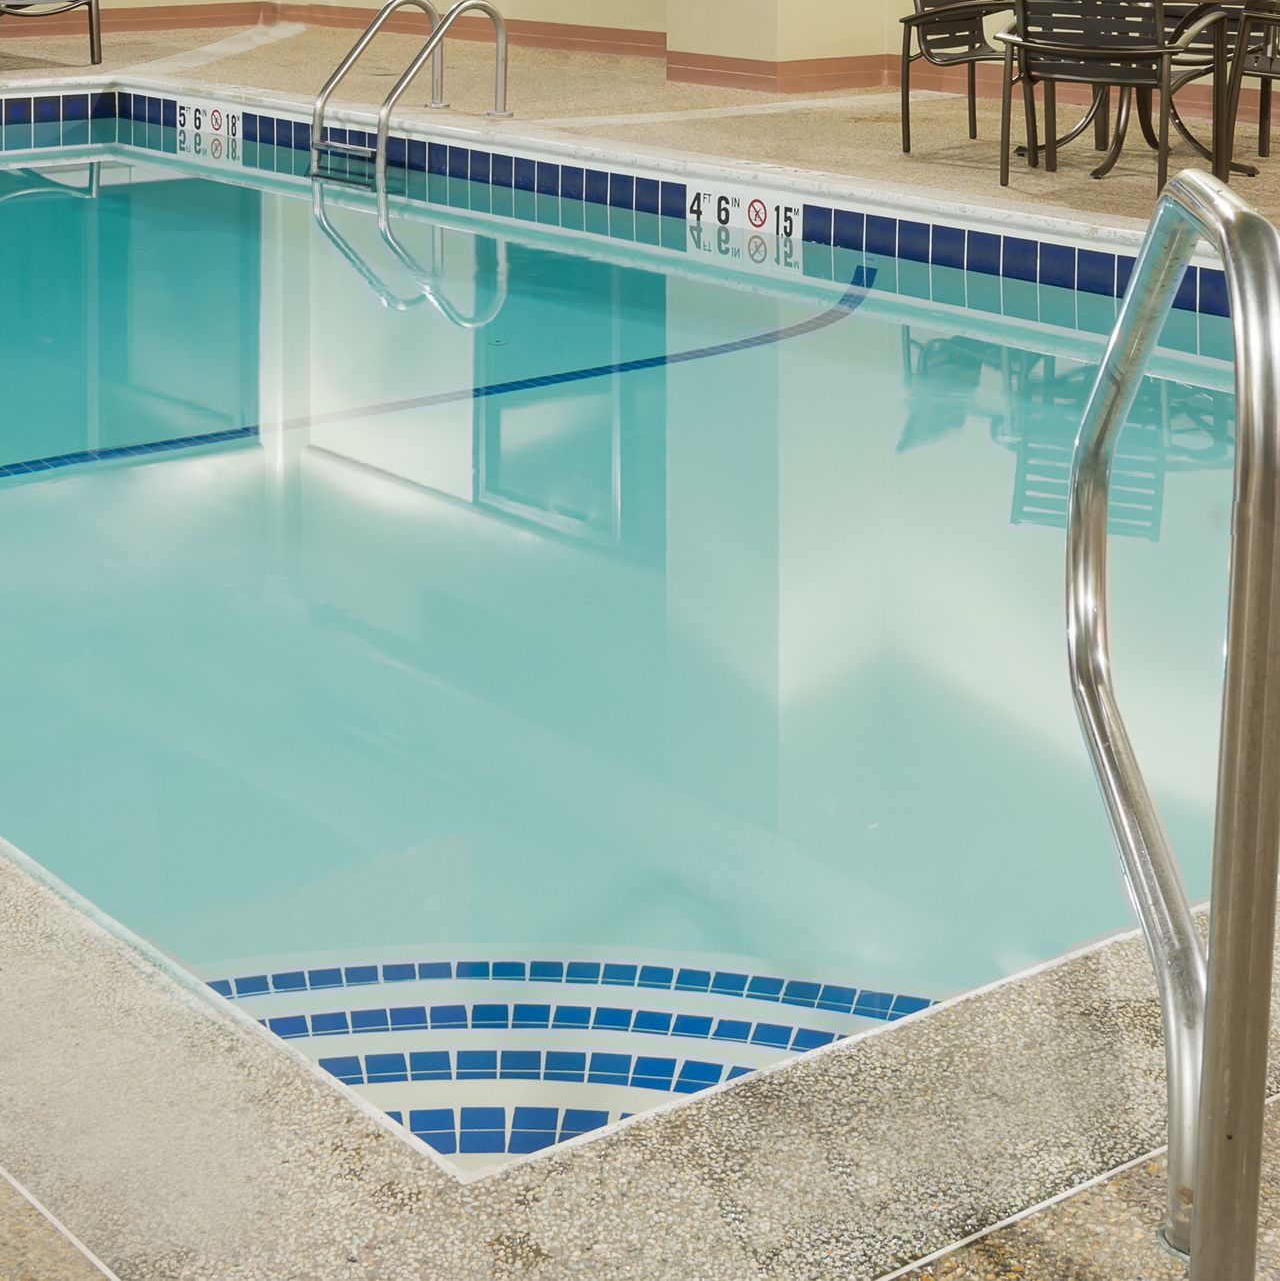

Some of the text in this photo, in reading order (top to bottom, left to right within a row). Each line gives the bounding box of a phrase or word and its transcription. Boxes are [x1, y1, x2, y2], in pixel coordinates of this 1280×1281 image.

[179, 106, 186, 127] 5
[194, 108, 201, 130] 6
[689, 192, 800, 238] 4 FT 6 IN 1.5 M
